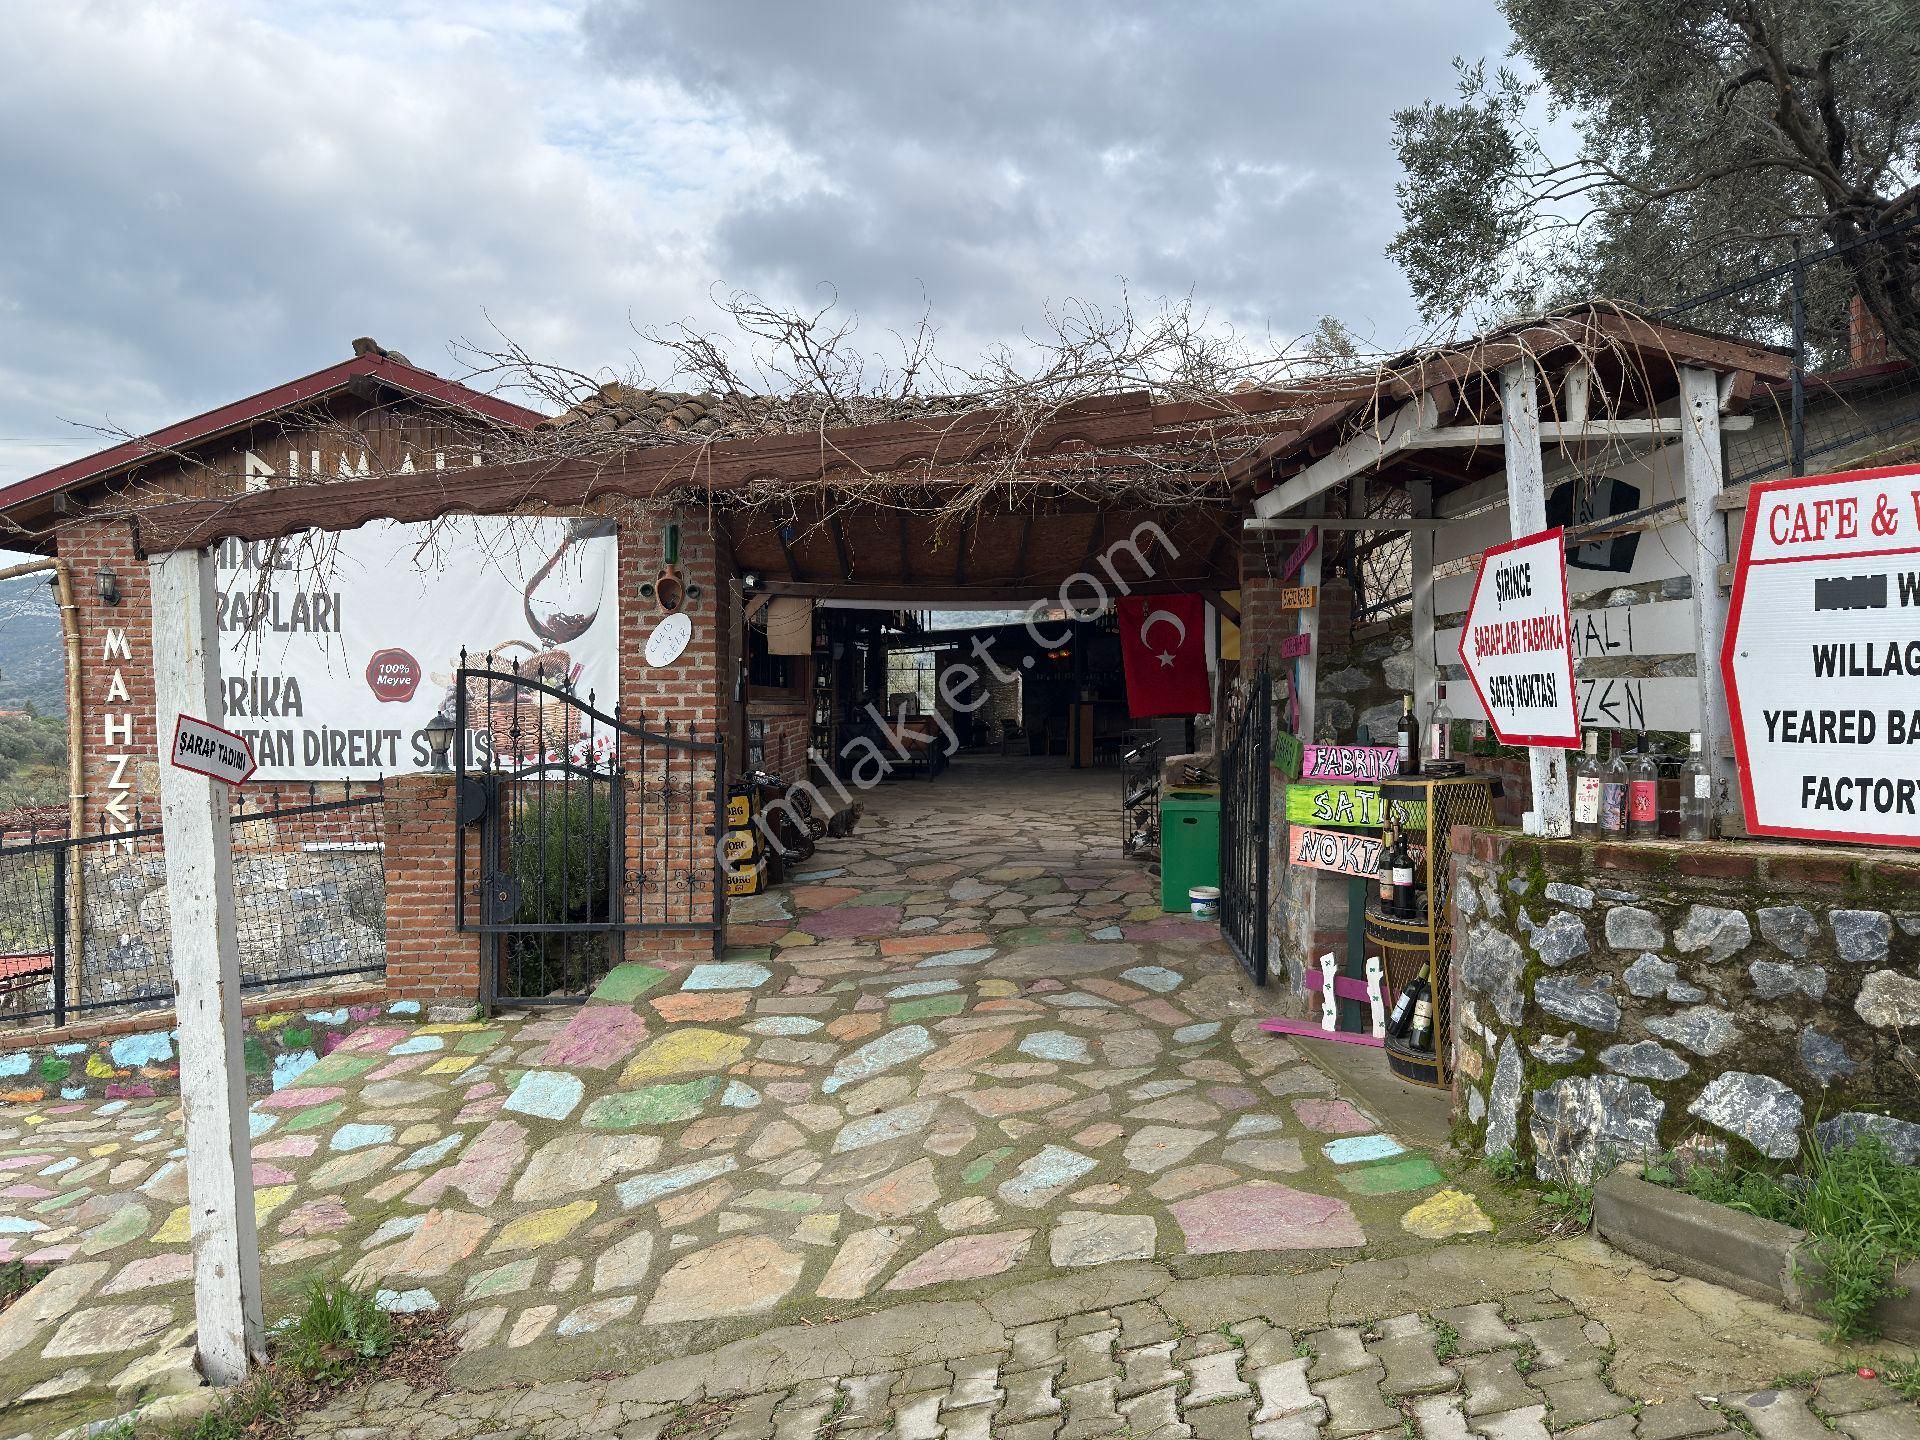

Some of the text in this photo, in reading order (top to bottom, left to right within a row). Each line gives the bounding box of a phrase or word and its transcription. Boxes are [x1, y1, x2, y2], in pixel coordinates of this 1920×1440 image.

[1769, 497, 1858, 545] CAFE
[1871, 493, 1898, 536] &
[1495, 560, 1532, 610] ŞİRİNCE
[1474, 606, 1564, 666] ŞARAPLARI FABRİKA
[377, 674, 411, 686] Meyve
[379, 664, 410, 674] 100%
[1490, 672, 1558, 716] SATIŞ NOKTASI
[1577, 679, 1646, 730] ZEN
[103, 628, 133, 856] MAHZEN
[303, 724, 402, 767] DİREKT
[1763, 710, 1876, 744] YEARED
[179, 731, 246, 772] ŞARAP TADIMI
